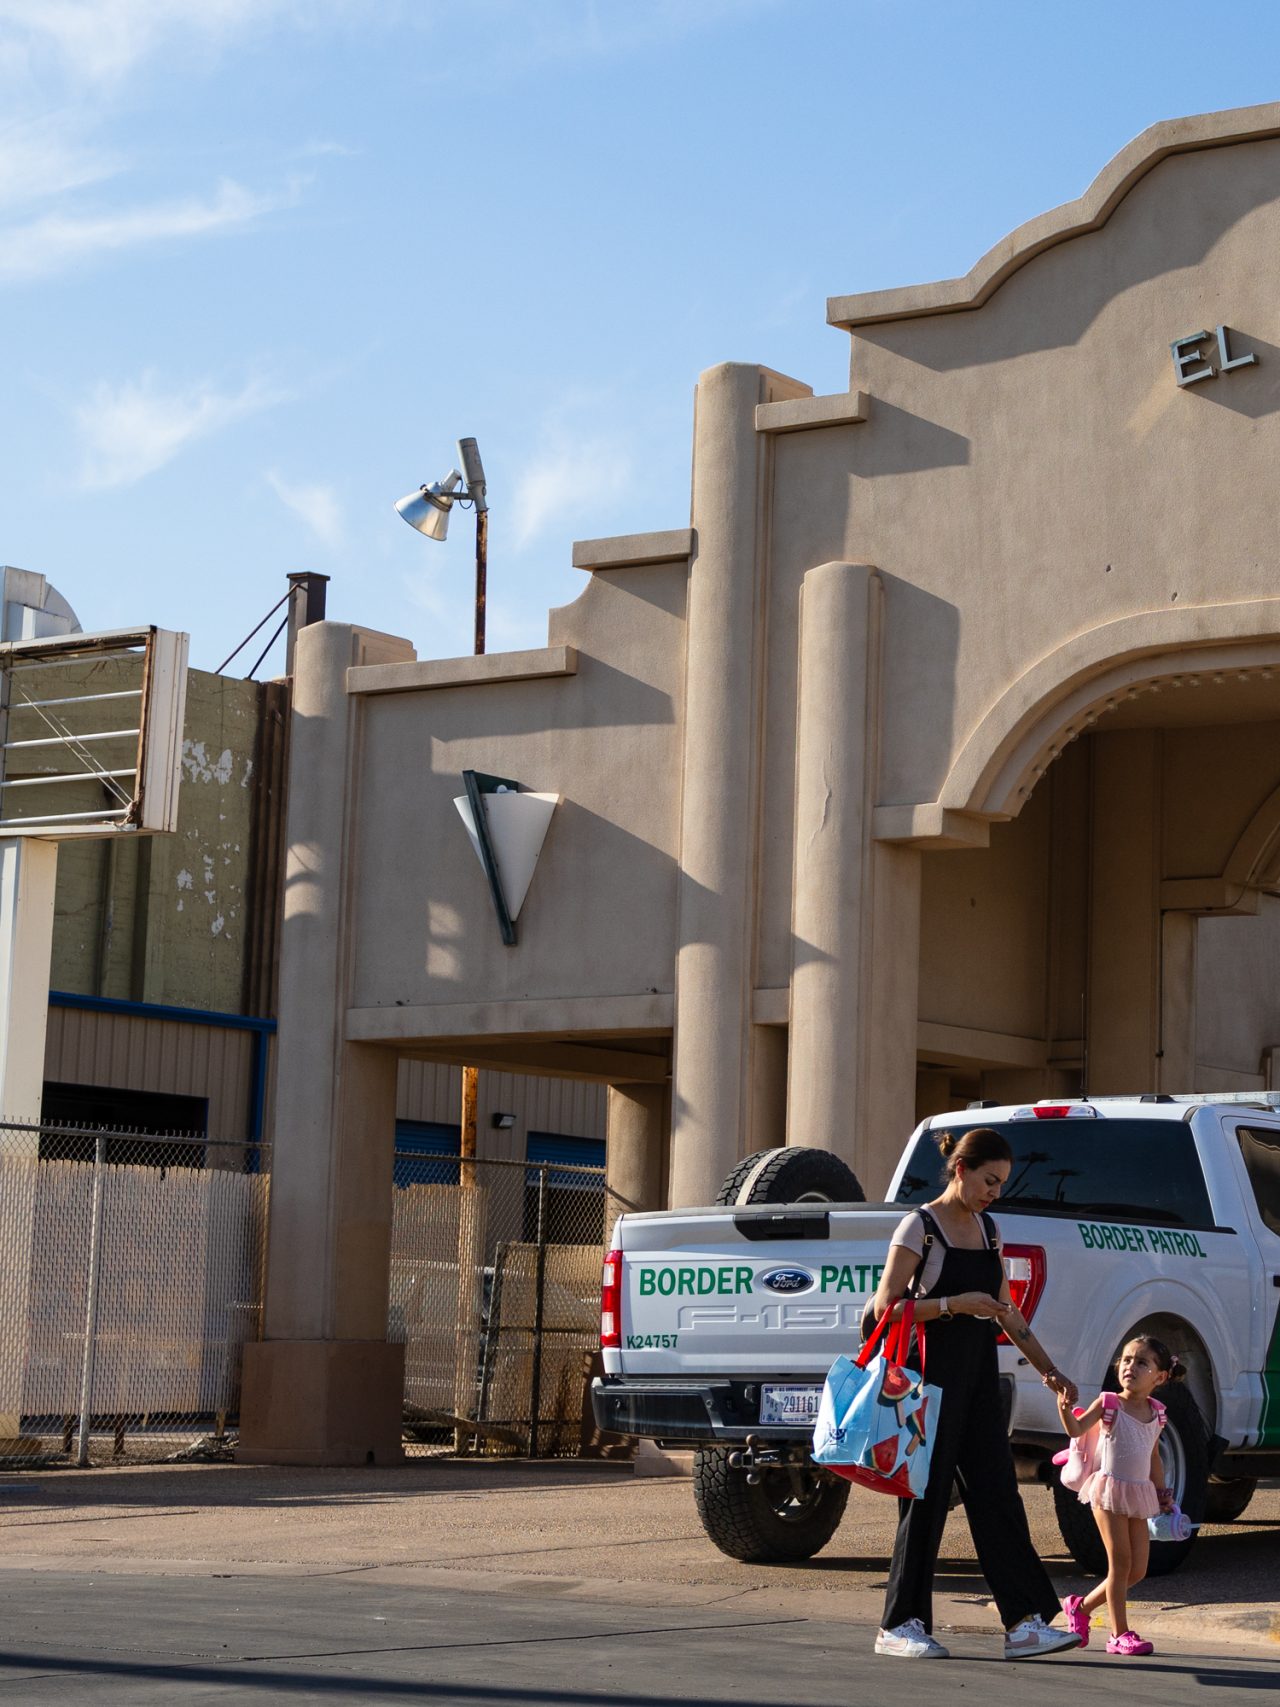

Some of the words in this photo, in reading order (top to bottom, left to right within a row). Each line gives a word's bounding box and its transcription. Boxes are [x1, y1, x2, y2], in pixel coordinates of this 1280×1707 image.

[1169, 325, 1260, 388] EL
[1077, 1223, 1149, 1253] BORDER
[1146, 1229, 1207, 1258] PATROL
[639, 1266, 754, 1296] BORDER
[772, 1273, 801, 1288] Ford
[626, 1334, 678, 1349] K24757
